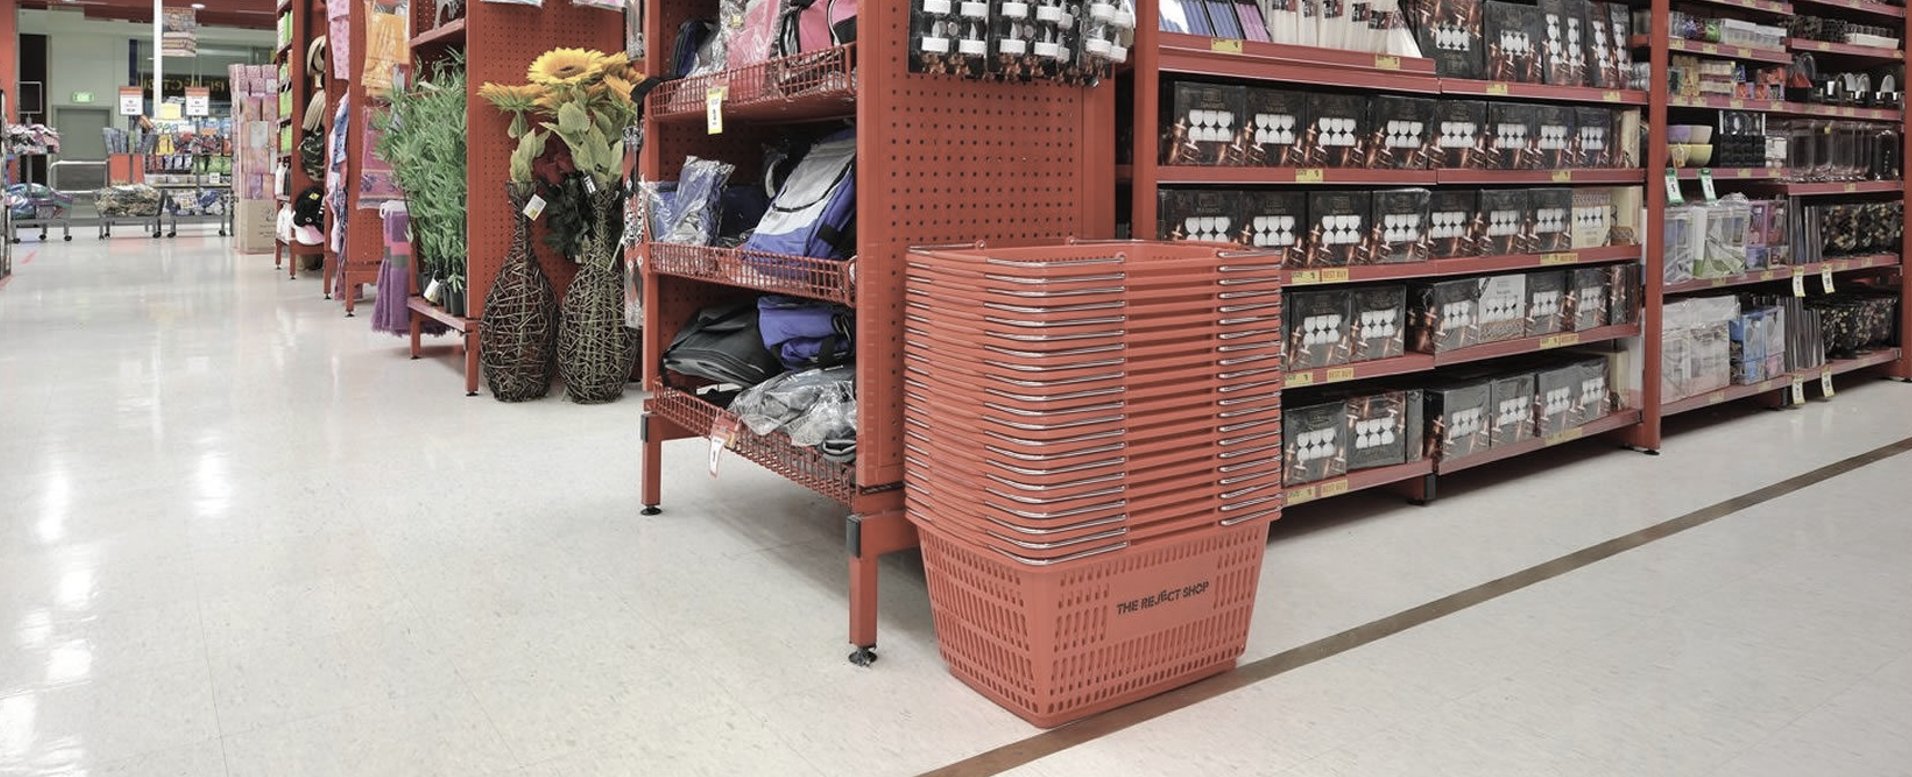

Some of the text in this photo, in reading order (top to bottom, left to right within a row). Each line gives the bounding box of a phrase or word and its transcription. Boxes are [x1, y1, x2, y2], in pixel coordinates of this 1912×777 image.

[1117, 580, 1210, 615] THE REJECT SHOP
